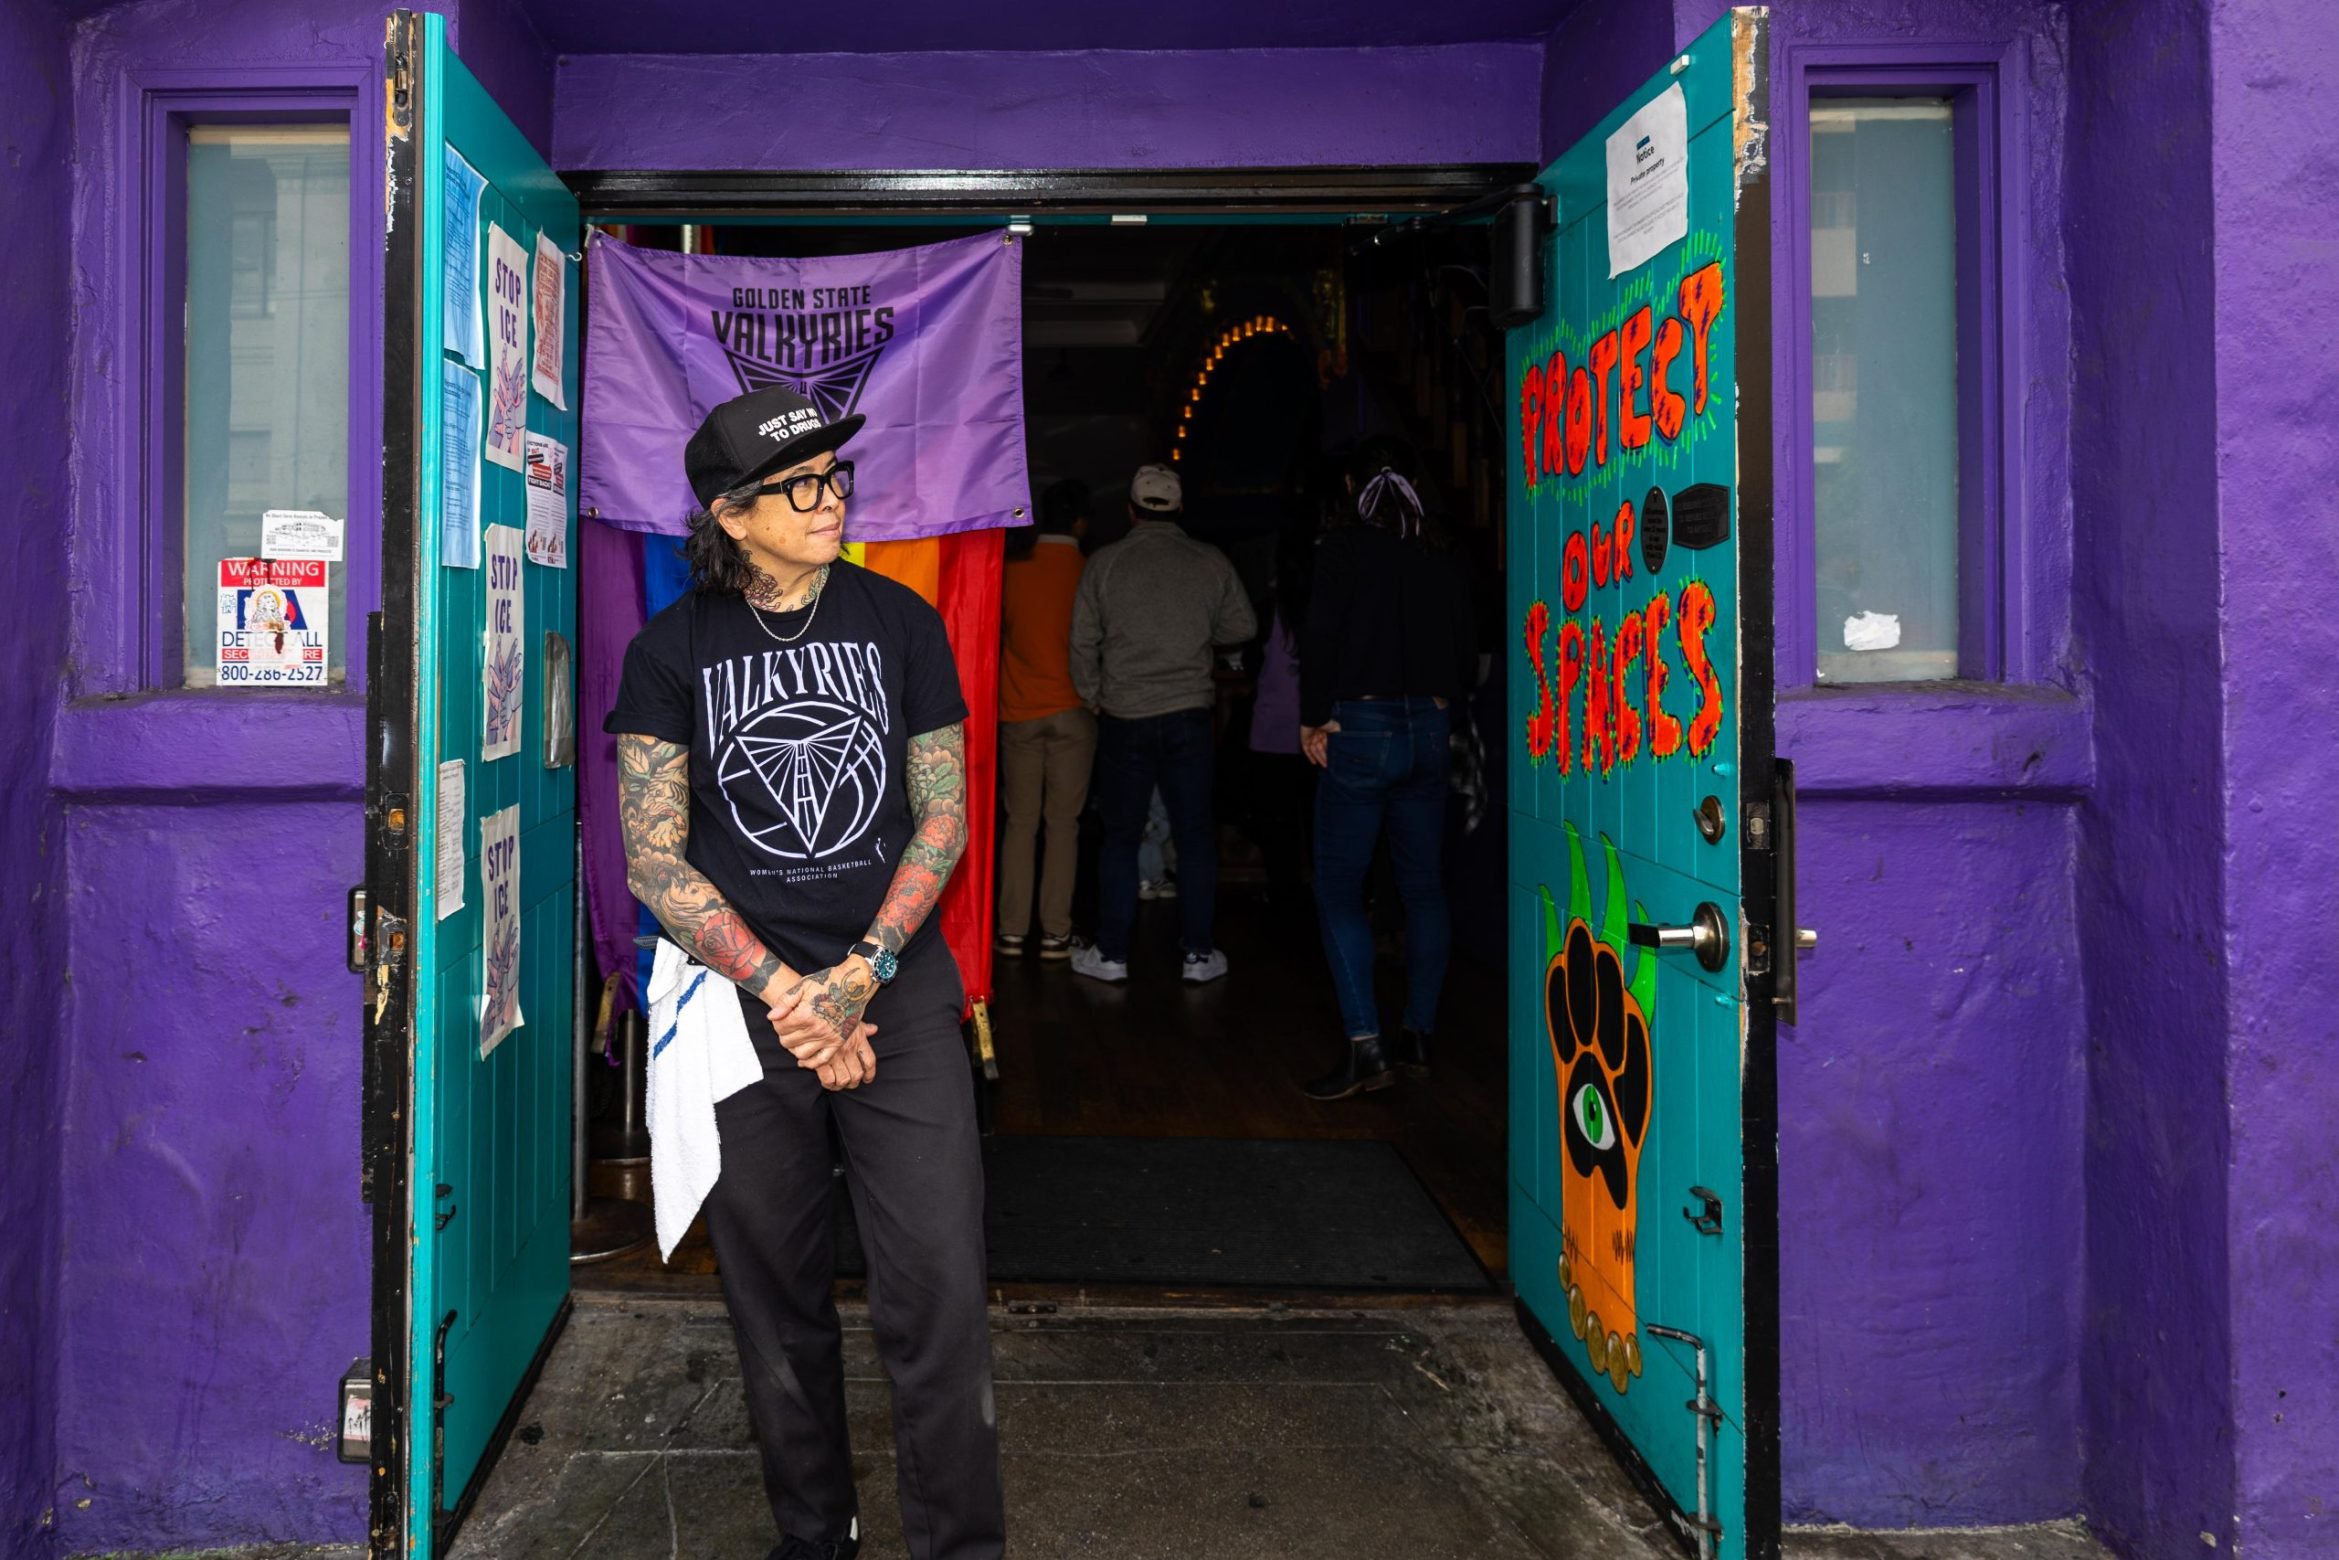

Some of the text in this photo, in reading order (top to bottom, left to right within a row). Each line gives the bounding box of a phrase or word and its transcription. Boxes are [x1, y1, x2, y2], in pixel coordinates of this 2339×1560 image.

[1636, 146, 1655, 164] Notice
[495, 257, 521, 308] STOP
[733, 285, 871, 309] GOLDEN STATE
[500, 305, 517, 348] ICE
[711, 307, 894, 369] VALKYRIES
[1521, 262, 1723, 488] PROTECT
[758, 414, 788, 436] JUST
[788, 408, 807, 422] SAY
[769, 418, 822, 442] TO DRUGS
[491, 554, 517, 590] STOP
[1563, 499, 1634, 614] OUR
[495, 598, 512, 633] ICE
[221, 665, 323, 681] 800-286-2527
[1525, 578, 1723, 777] SPACES
[702, 642, 889, 760] VALKYRIES
[488, 835, 514, 882] STOP
[786, 867, 824, 875] NATIONAL
[827, 859, 872, 872] BASKETBALL
[786, 873, 838, 883] ASSOCIATION
[495, 880, 509, 923] ICE
